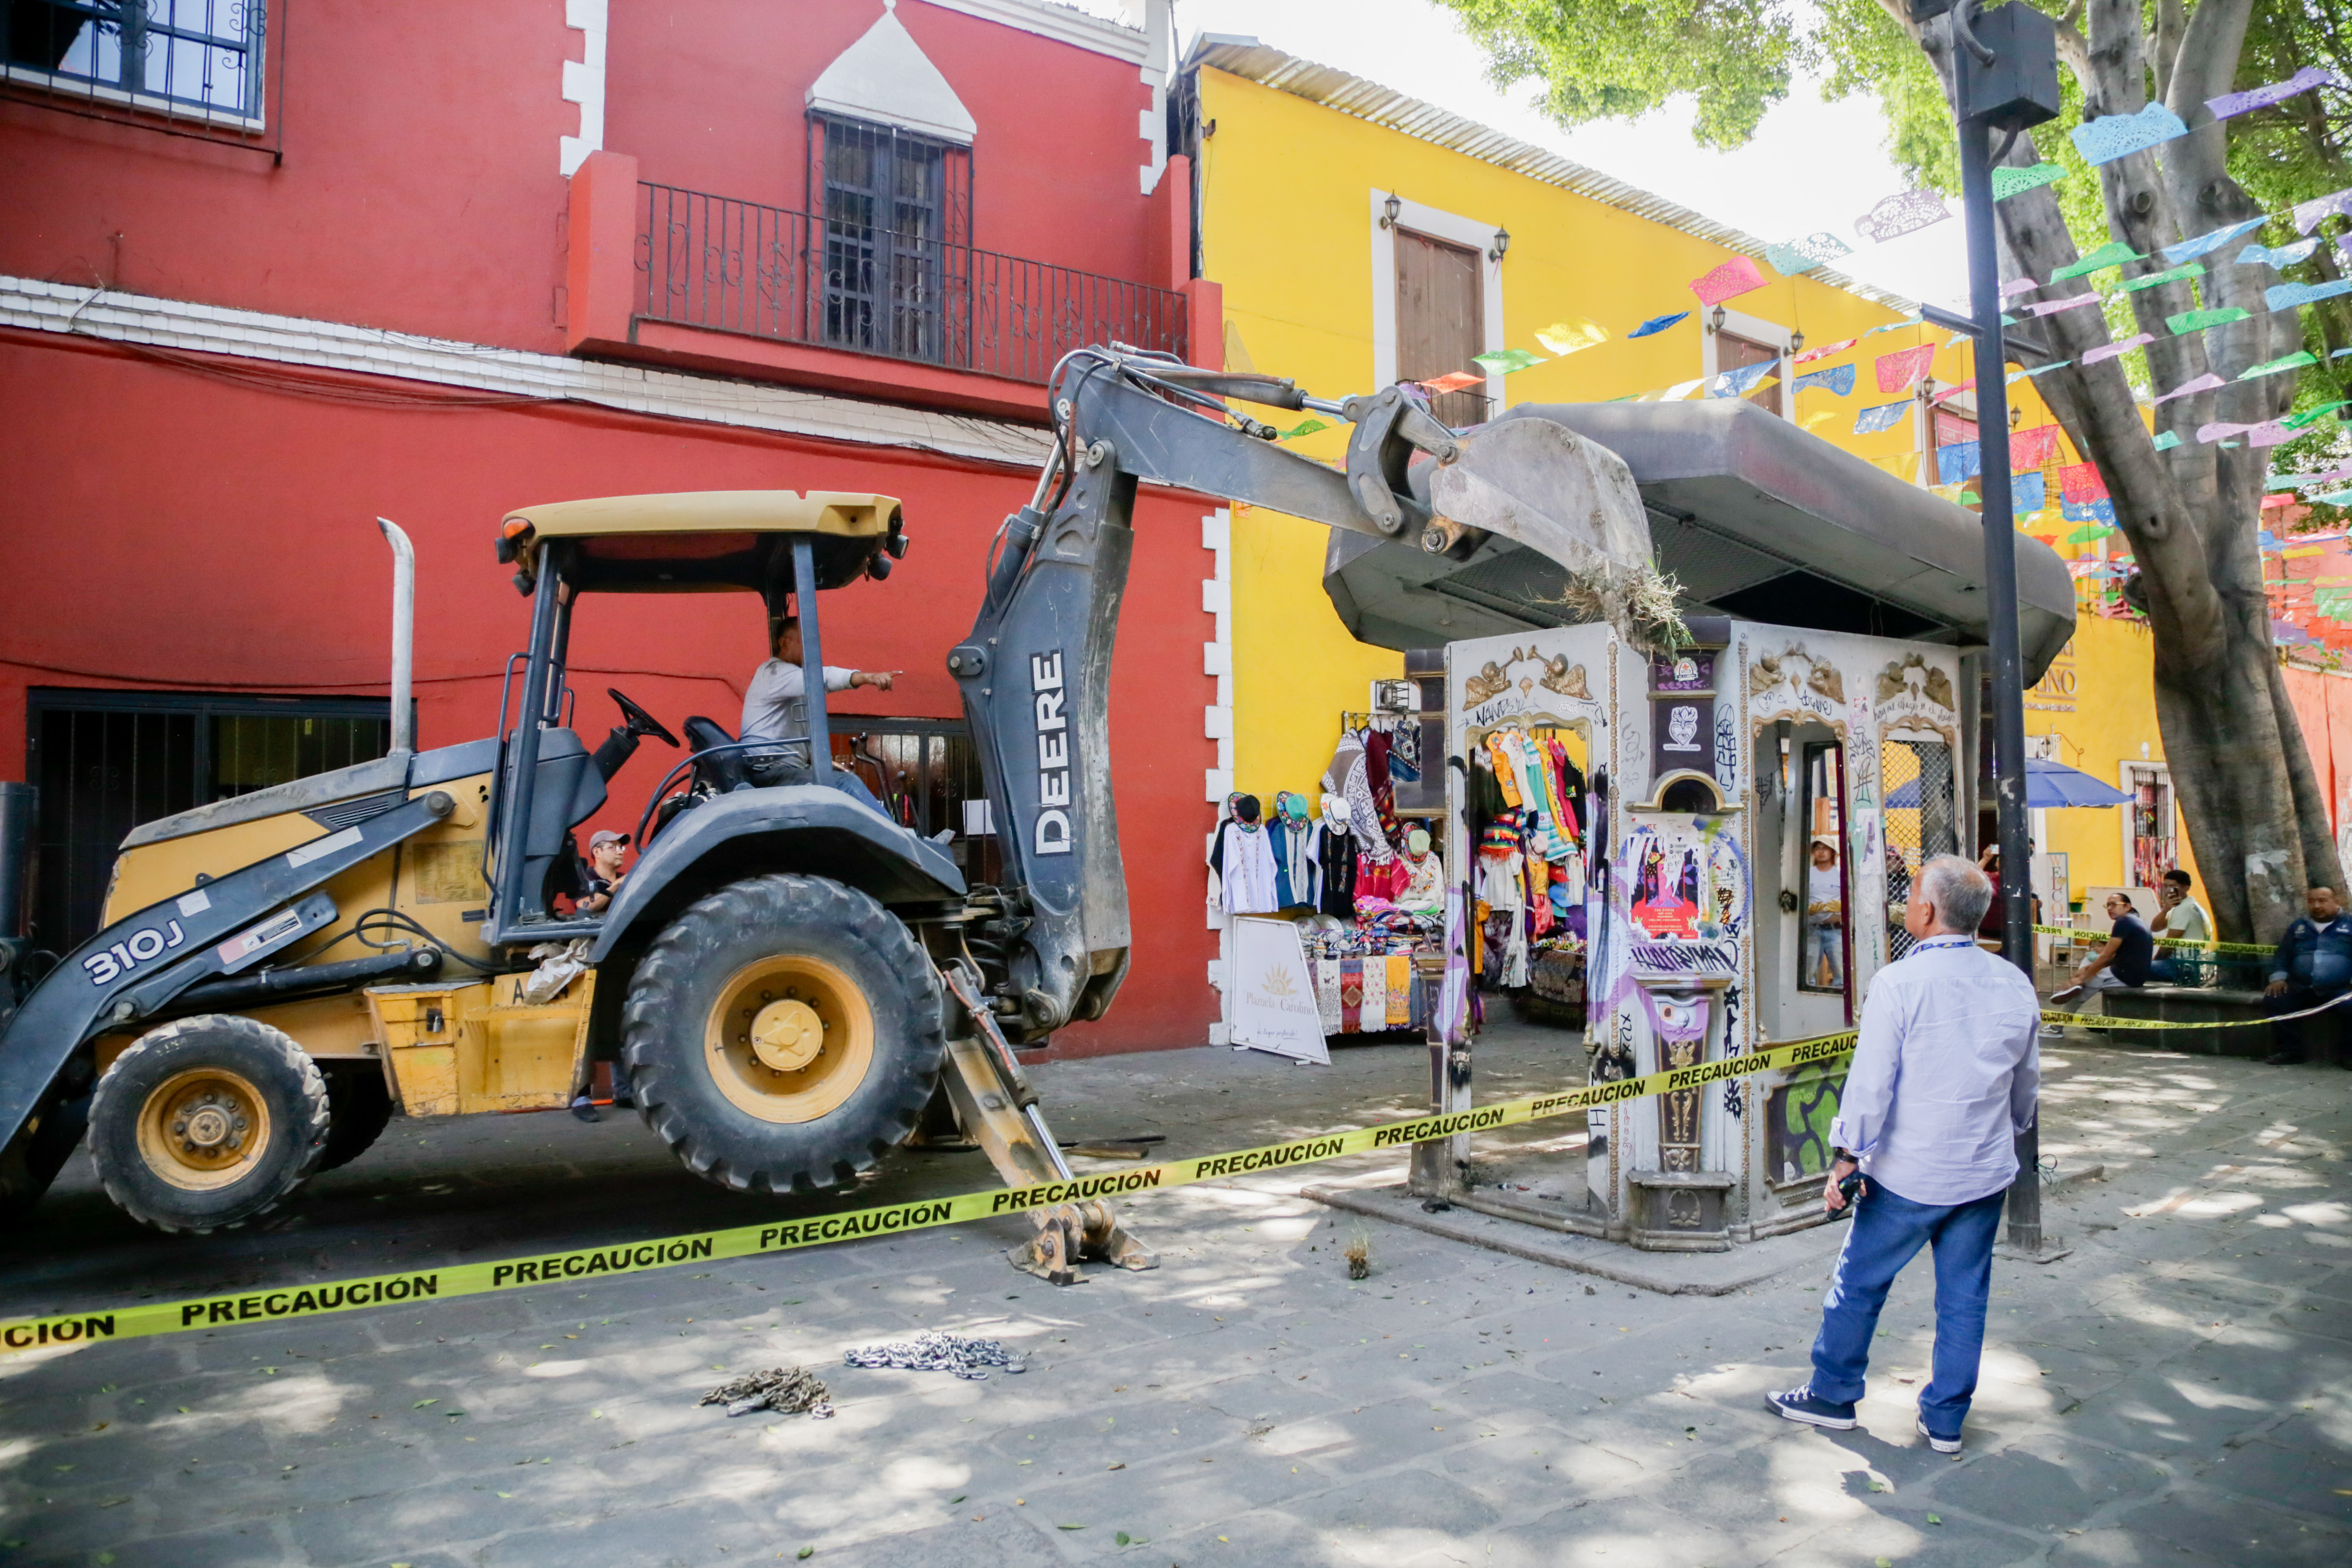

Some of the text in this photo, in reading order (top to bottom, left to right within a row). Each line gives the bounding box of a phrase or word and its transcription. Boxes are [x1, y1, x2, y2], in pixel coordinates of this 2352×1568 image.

[1032, 651, 1071, 855] DEERE
[2049, 854, 2063, 938] WELCOM
[82, 918, 185, 986] 310J
[1247, 992, 1314, 1015] Plazuela Carolino
[0, 1315, 115, 1348] CIÓN
[182, 1275, 437, 1326] PRECAUCIÓN
[493, 1238, 713, 1286] PRECAUCIÓN
[760, 1202, 951, 1248] PRECAUCIÓN
[992, 1170, 1161, 1212] PRECAUCIÓN
[1196, 1138, 1343, 1178] PRECAUCIÓN
[1374, 1108, 1504, 1147] PRECAUCIÓN
[1531, 1079, 1645, 1117] PRECAUCIÓN
[1669, 1054, 1770, 1089] PRECAUCIÓN
[1792, 1035, 1858, 1062] PRECAUC
